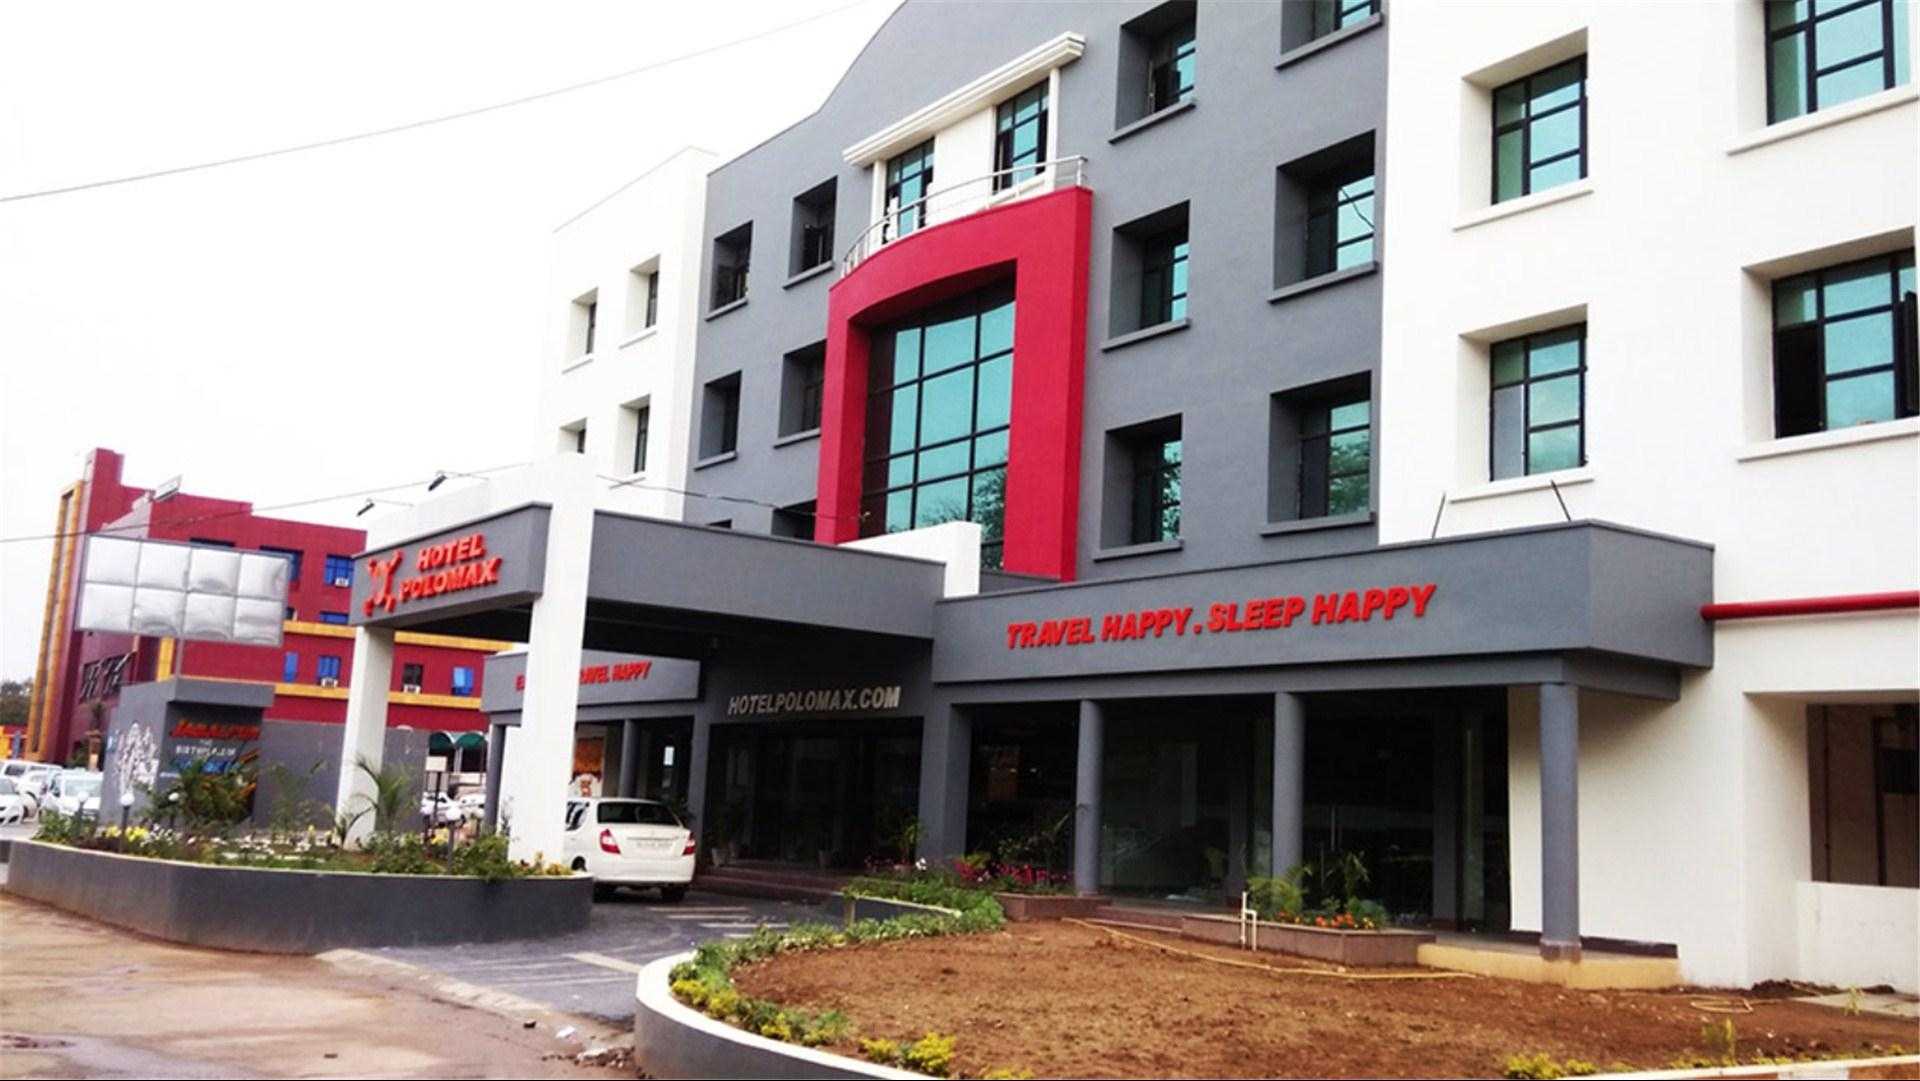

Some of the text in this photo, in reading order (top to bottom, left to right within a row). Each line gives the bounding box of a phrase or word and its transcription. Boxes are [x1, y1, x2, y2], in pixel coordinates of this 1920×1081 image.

[417, 533, 487, 571] HOTEL
[399, 556, 502, 602] POLOMAX
[1006, 616, 1095, 649] TRAVEL
[1208, 596, 1306, 633] SLEEP
[1311, 584, 1437, 625] HAPPY
[611, 660, 652, 683] HAPPY
[727, 685, 901, 715] HOTELPOLOMAX.COM
